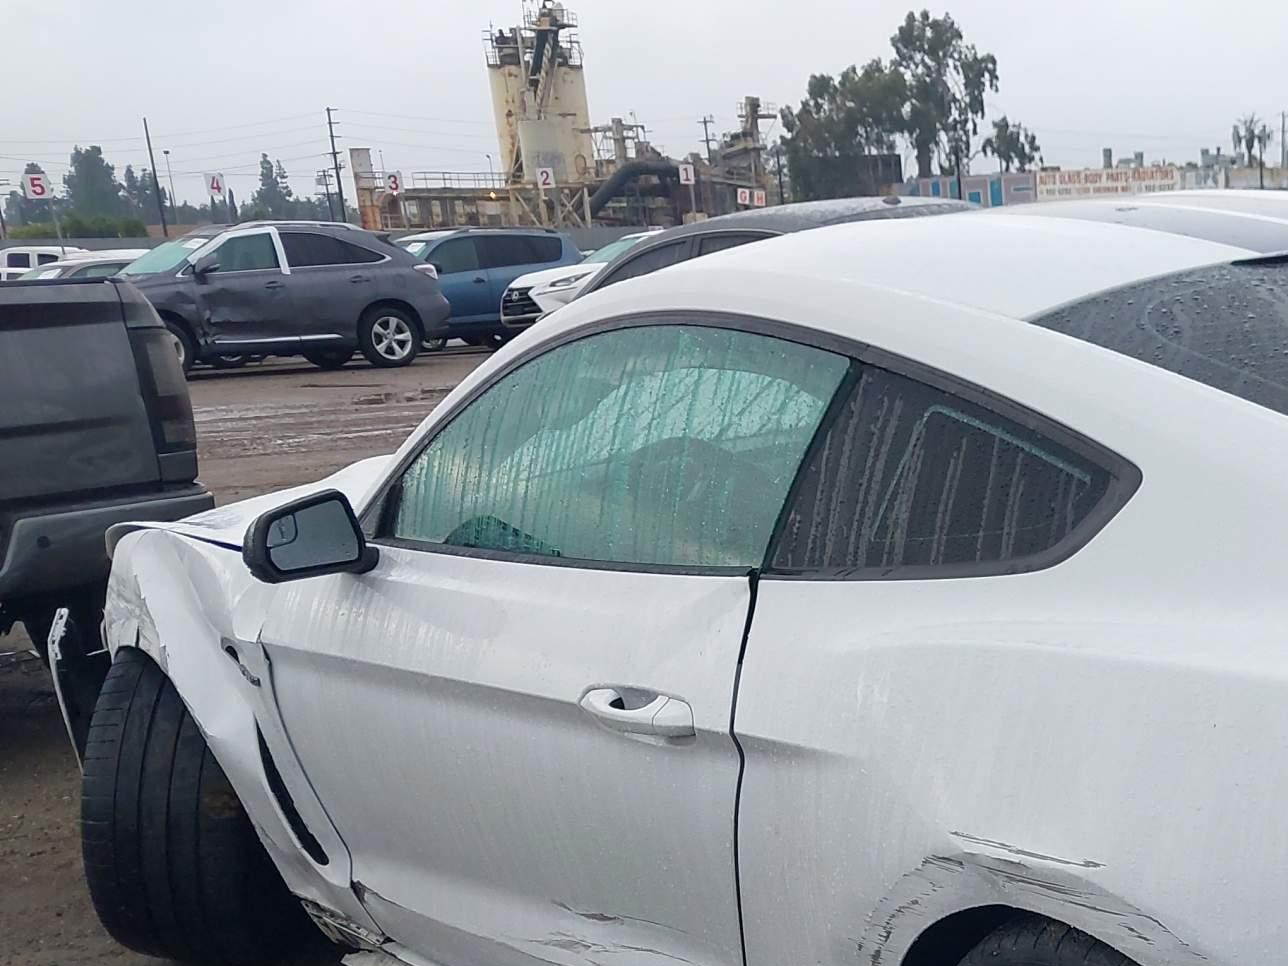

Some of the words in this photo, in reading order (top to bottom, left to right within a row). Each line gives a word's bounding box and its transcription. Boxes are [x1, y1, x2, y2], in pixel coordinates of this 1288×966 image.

[388, 174, 399, 191] 3
[540, 170, 551, 186] 2
[683, 167, 691, 181] 1
[30, 177, 46, 196] 5
[210, 175, 222, 193] 4
